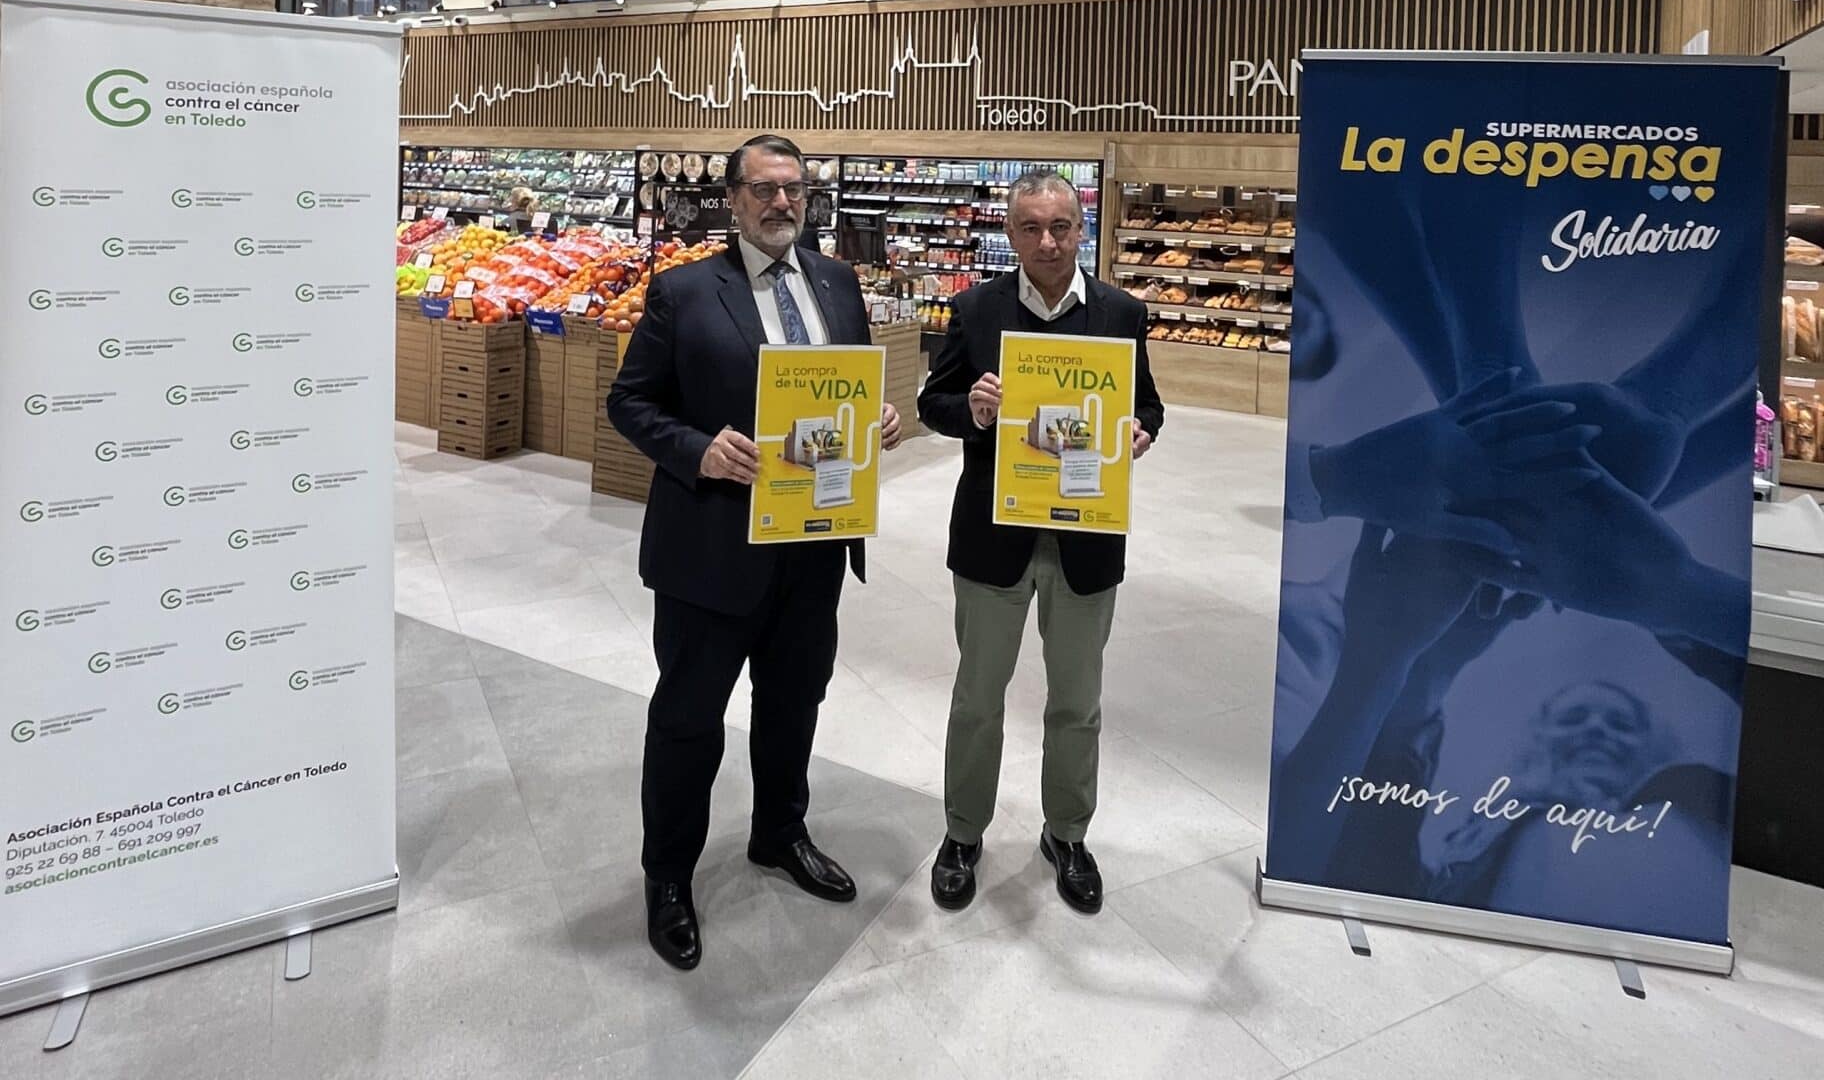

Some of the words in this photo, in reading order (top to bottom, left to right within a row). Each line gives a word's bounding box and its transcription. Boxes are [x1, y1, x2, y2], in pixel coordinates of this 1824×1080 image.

[166, 80, 255, 96] asociación
[260, 85, 333, 99] española
[165, 96, 221, 109] contra
[225, 98, 240, 110] el
[244, 99, 301, 113] cáncer
[977, 103, 1047, 126] Toledo
[164, 114, 186, 125] en
[190, 113, 247, 127] Toledo
[1486, 121, 1699, 142] SUPERMERCADOS
[1340, 126, 1405, 172] La
[1422, 128, 1722, 187] despensa
[700, 197, 719, 209] NOS
[1541, 209, 1721, 273] Solidaria
[1018, 351, 1033, 363] La
[1035, 353, 1083, 366] compra
[775, 364, 790, 376] La
[792, 365, 838, 378] compra
[1017, 363, 1034, 375] de
[1037, 365, 1050, 376] tu
[1053, 369, 1118, 391] VIDA
[775, 376, 792, 388] de
[794, 377, 806, 388] tu
[809, 379, 868, 400] VIDA
[7, 816, 92, 845] Asociación
[96, 800, 163, 824] Española
[167, 790, 215, 808] Contra
[217, 785, 231, 797] el
[233, 776, 282, 793] Cáncer
[284, 770, 301, 783] en
[303, 760, 348, 778] Toledo
[1473, 776, 1531, 821] de
[109, 819, 154, 837] 45004
[157, 807, 205, 825] Toledo
[5, 862, 34, 880] 925
[37, 857, 55, 871] 22
[59, 852, 78, 865] 69
[82, 845, 101, 859] 88
[118, 837, 142, 851] 691
[146, 830, 173, 845] 209
[176, 823, 202, 840] 997
[4, 835, 219, 895] asociacioncontraelcancer.es
